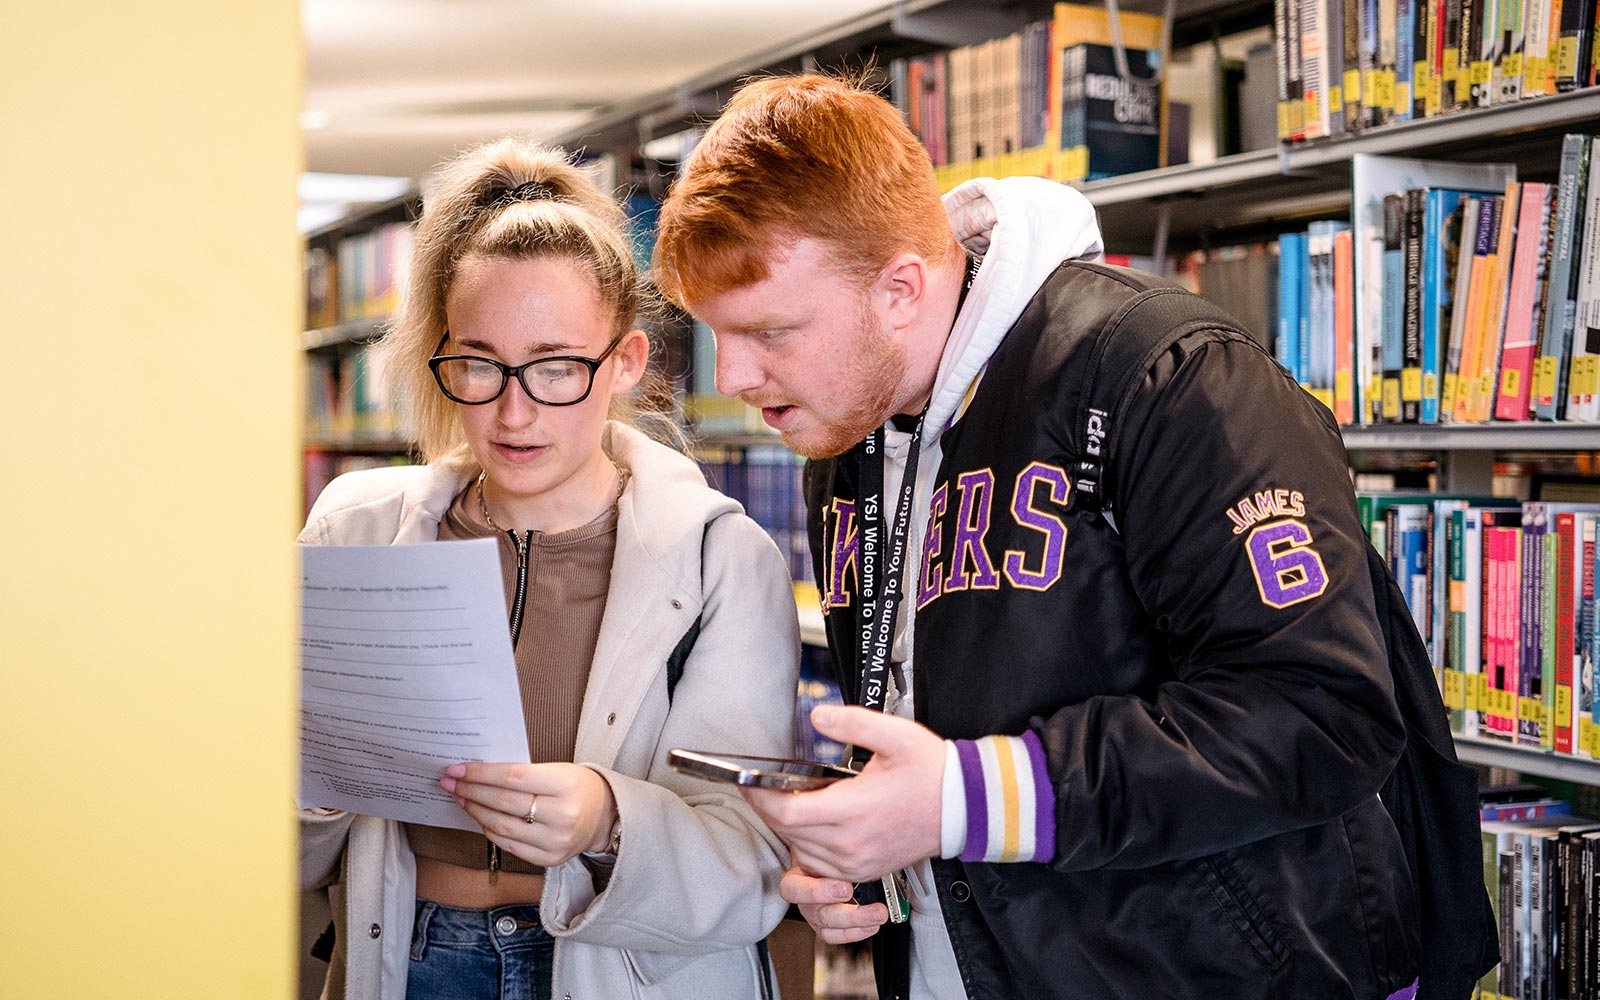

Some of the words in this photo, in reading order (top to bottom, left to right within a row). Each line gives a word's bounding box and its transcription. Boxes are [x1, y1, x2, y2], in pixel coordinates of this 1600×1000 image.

[864, 494, 878, 521] YSJ
[895, 485, 912, 537] Future
[1226, 489, 1306, 535] JAMES
[817, 460, 1072, 616] KERS
[888, 539, 903, 575] Your
[863, 527, 878, 598] Welcome
[1244, 518, 1330, 610] 6
[862, 600, 876, 618] To
[884, 578, 897, 597] To
[870, 600, 894, 672] Welcome
[865, 679, 882, 707] YSJ
